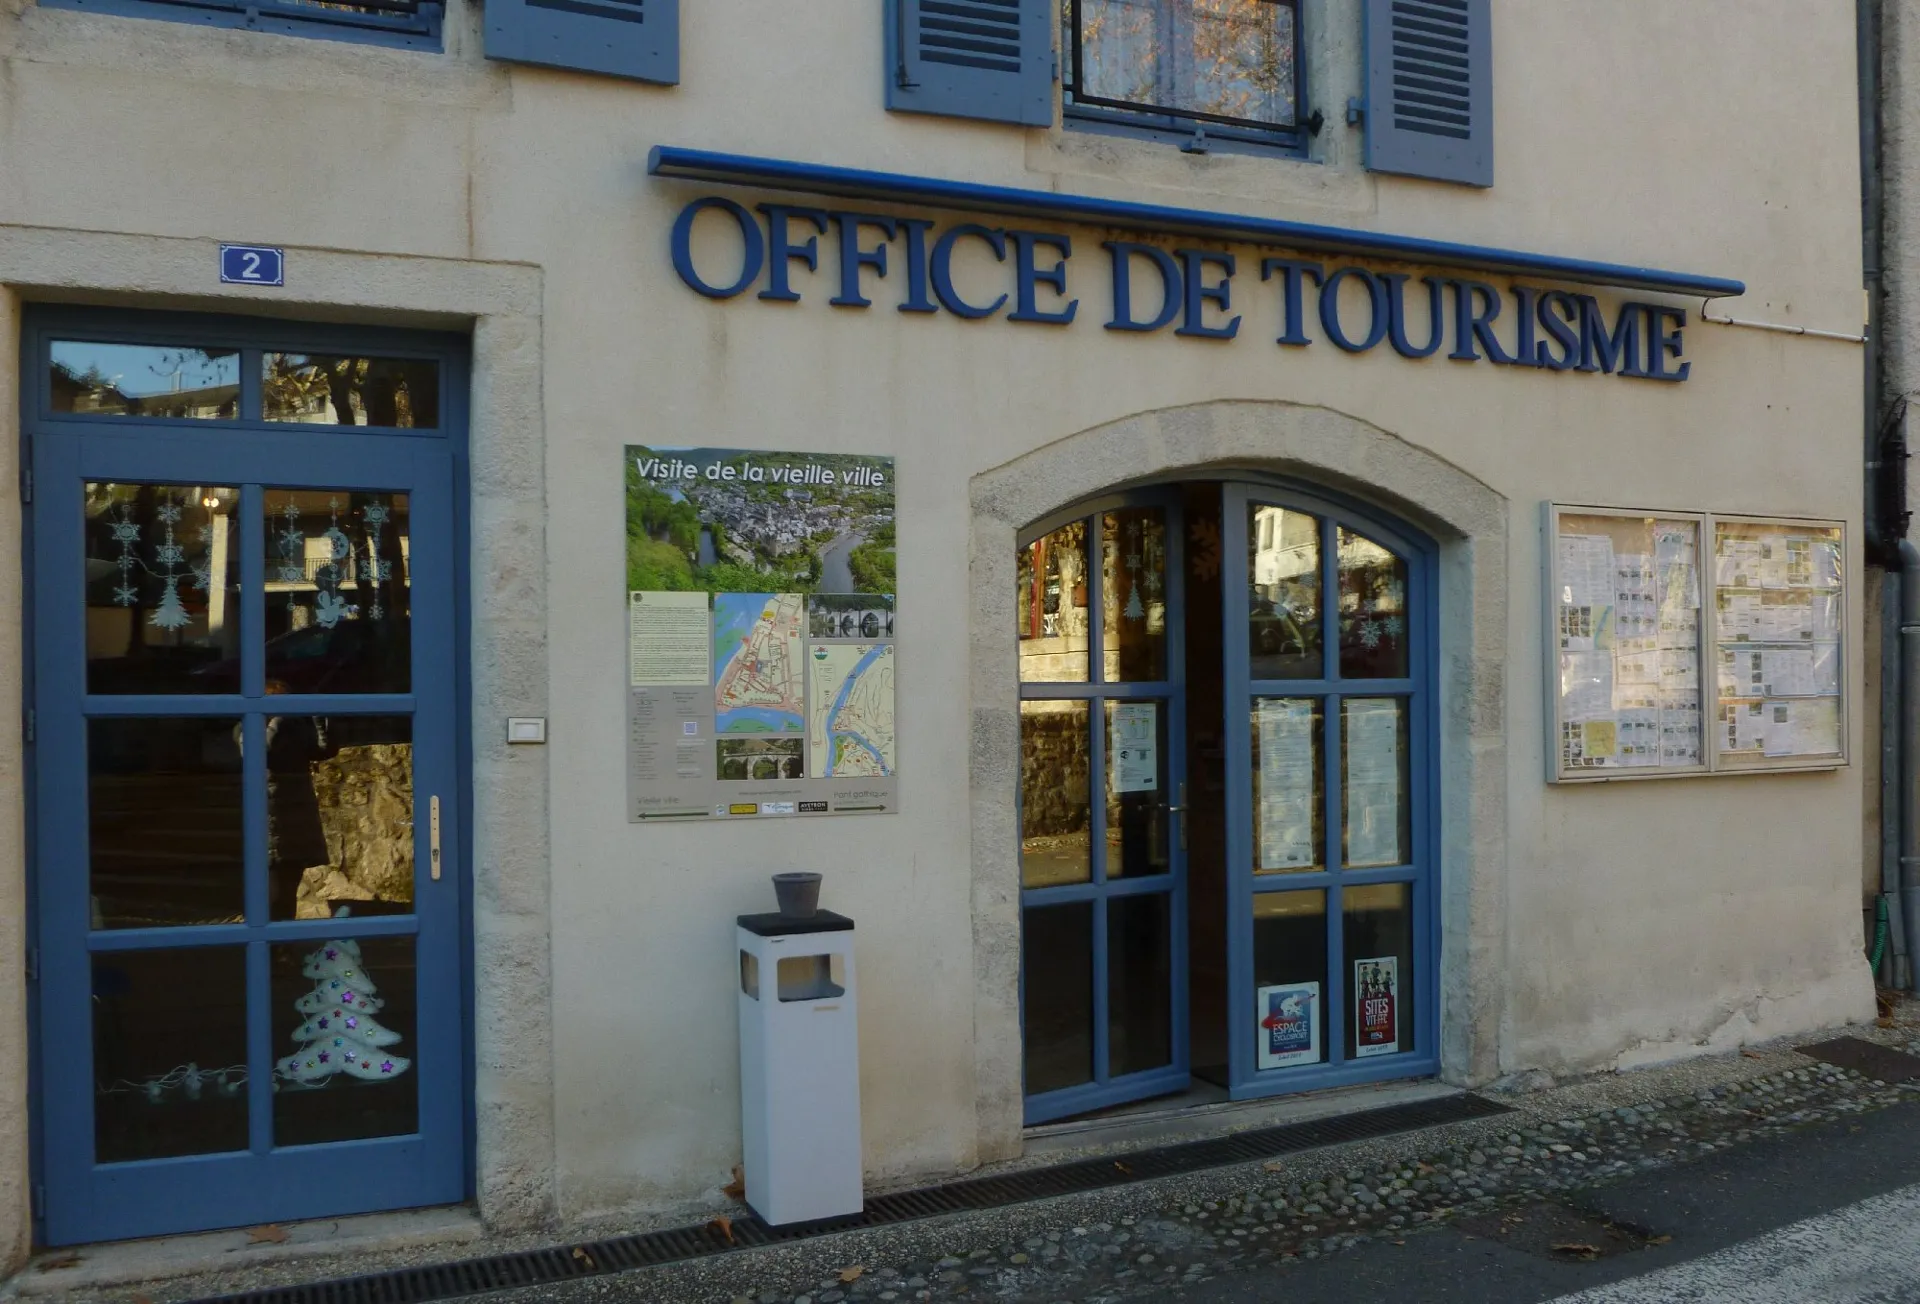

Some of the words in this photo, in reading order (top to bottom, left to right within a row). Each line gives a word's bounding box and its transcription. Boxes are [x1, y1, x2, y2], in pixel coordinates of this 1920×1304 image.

[242, 252, 261, 278] 2
[671, 197, 1079, 325] OFFICE
[1102, 242, 1242, 339] DE
[1261, 258, 1692, 382] TOURISME
[636, 458, 698, 480] Visite
[705, 461, 736, 480] de
[742, 462, 764, 482] la
[771, 463, 835, 485] vieille
[842, 466, 884, 487] ville
[1365, 998, 1389, 1016] SITES
[1272, 1020, 1308, 1035] ESPACE
